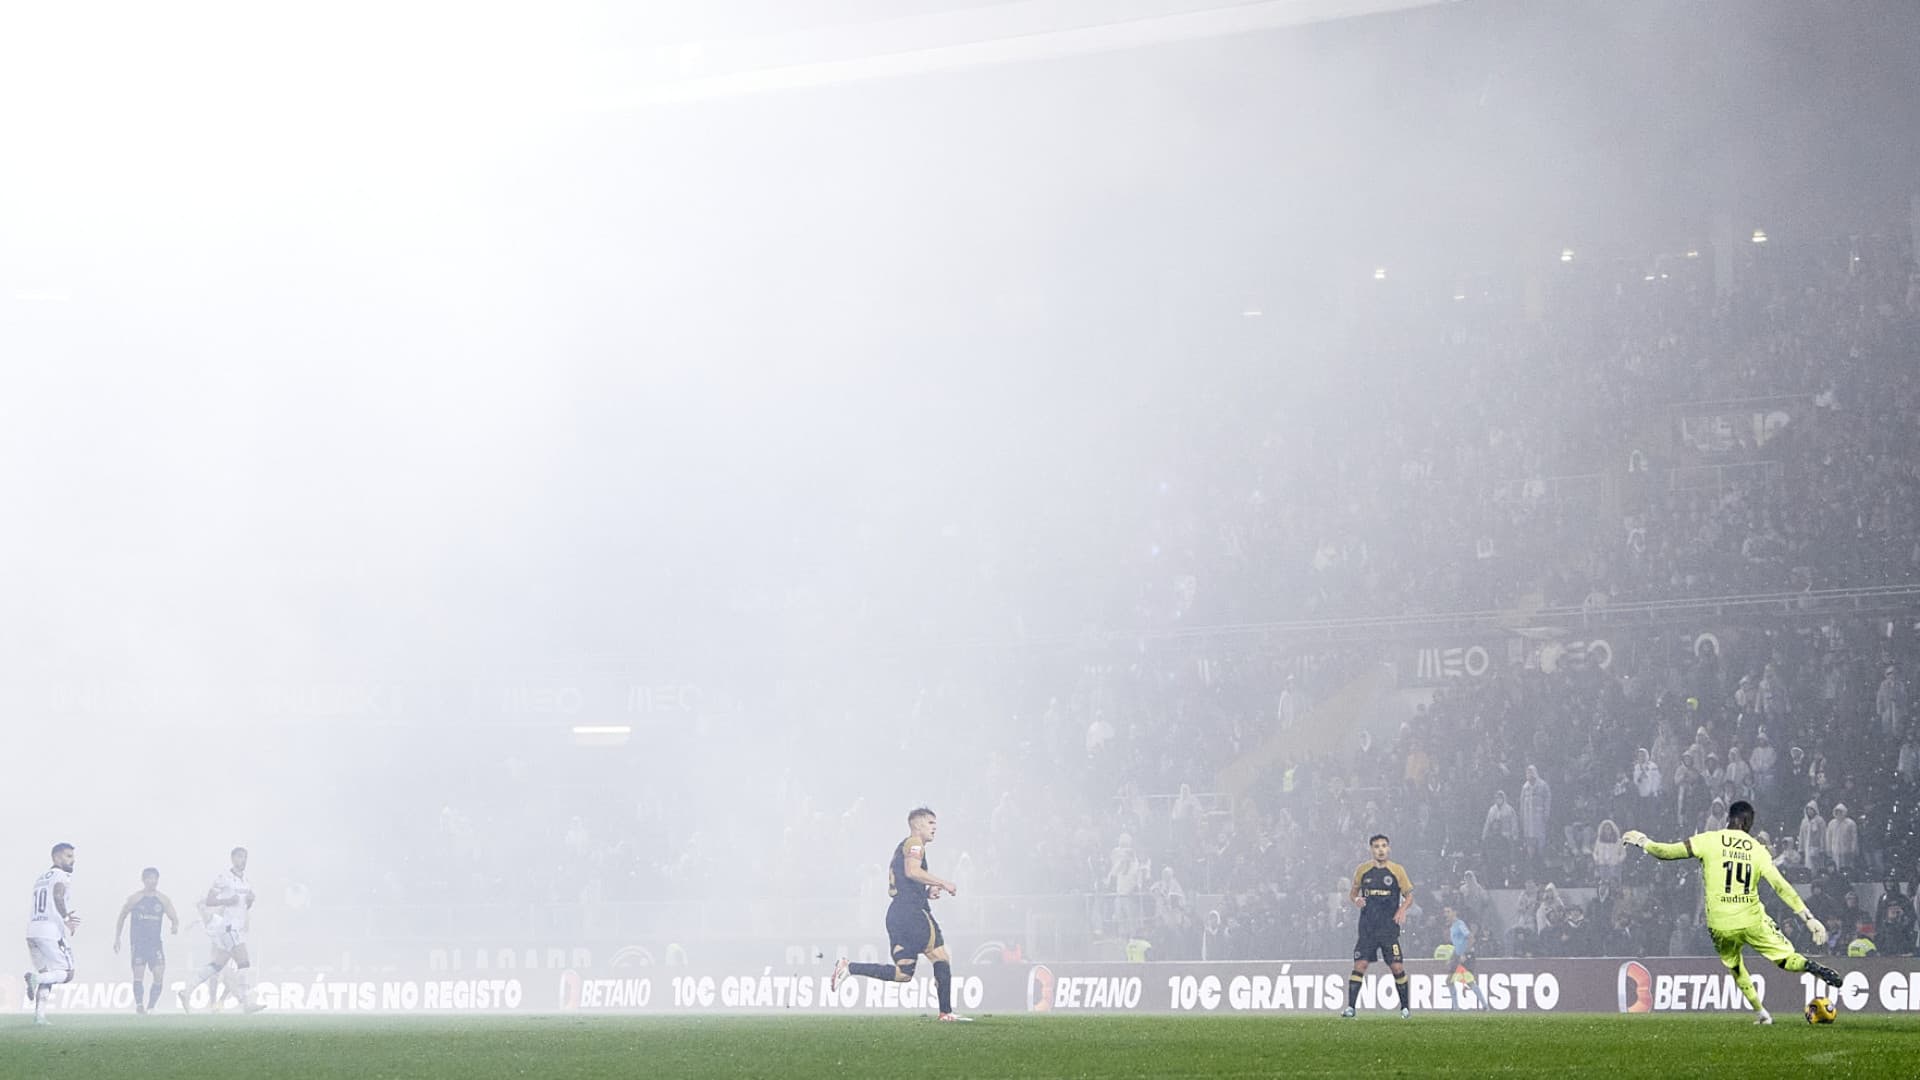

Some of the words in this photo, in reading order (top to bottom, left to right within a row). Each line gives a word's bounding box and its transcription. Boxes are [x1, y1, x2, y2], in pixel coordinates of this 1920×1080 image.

[1721, 835, 1753, 851] UZO
[1722, 860, 1752, 895] 14
[34, 887, 48, 915] 10
[254, 973, 376, 1010] GRÁTIS
[383, 981, 418, 1009] NO
[424, 980, 522, 1009] REGISTO
[580, 979, 651, 1008] BETANO
[672, 976, 716, 1007] 10€
[721, 966, 813, 1007] GRÁTIS
[819, 976, 859, 1008] NO
[865, 976, 984, 1009] REGISTO
[1054, 976, 1142, 1009] BETANO
[1168, 975, 1221, 1010] 10€
[1229, 963, 1344, 1010] GRÁTIS
[1354, 974, 1402, 1010] NO
[1410, 972, 1560, 1010] REGISTO
[1654, 973, 1766, 1010] BETANO
[1800, 971, 1870, 1011] 10€
